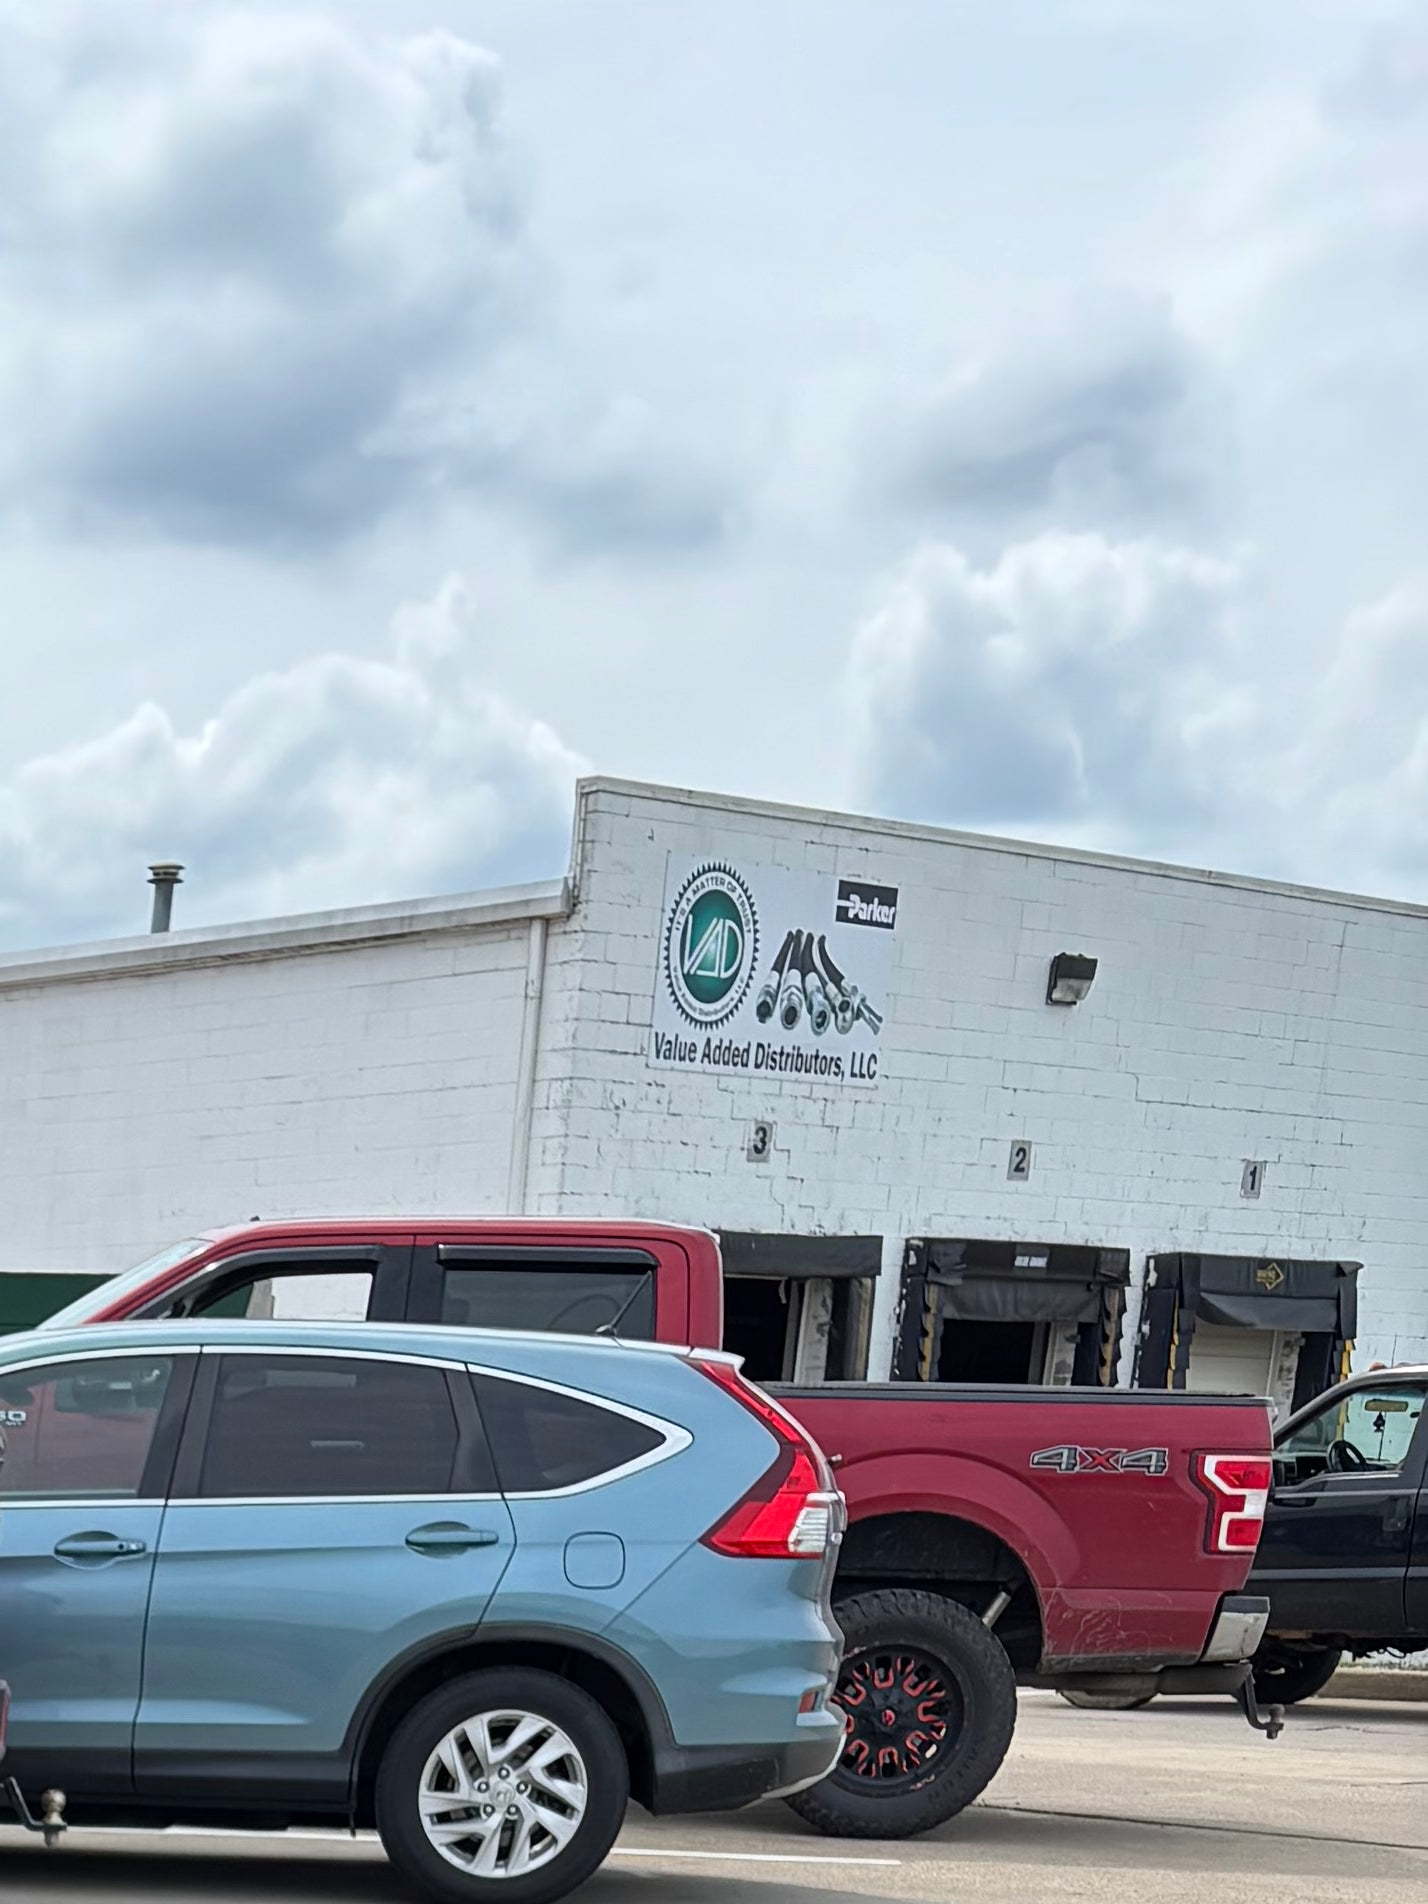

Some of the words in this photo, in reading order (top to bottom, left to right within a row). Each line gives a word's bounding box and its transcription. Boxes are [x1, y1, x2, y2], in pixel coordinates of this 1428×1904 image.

[692, 876, 726, 895] MATTER
[848, 894, 897, 925] Parker
[654, 1031, 697, 1063] Value
[700, 1036, 750, 1069] Added
[754, 1041, 846, 1082] Distributors,
[850, 1051, 878, 1081] LLC
[753, 1122, 769, 1155] 3
[1013, 1147, 1027, 1174] 2
[1247, 1165, 1258, 1192] 1
